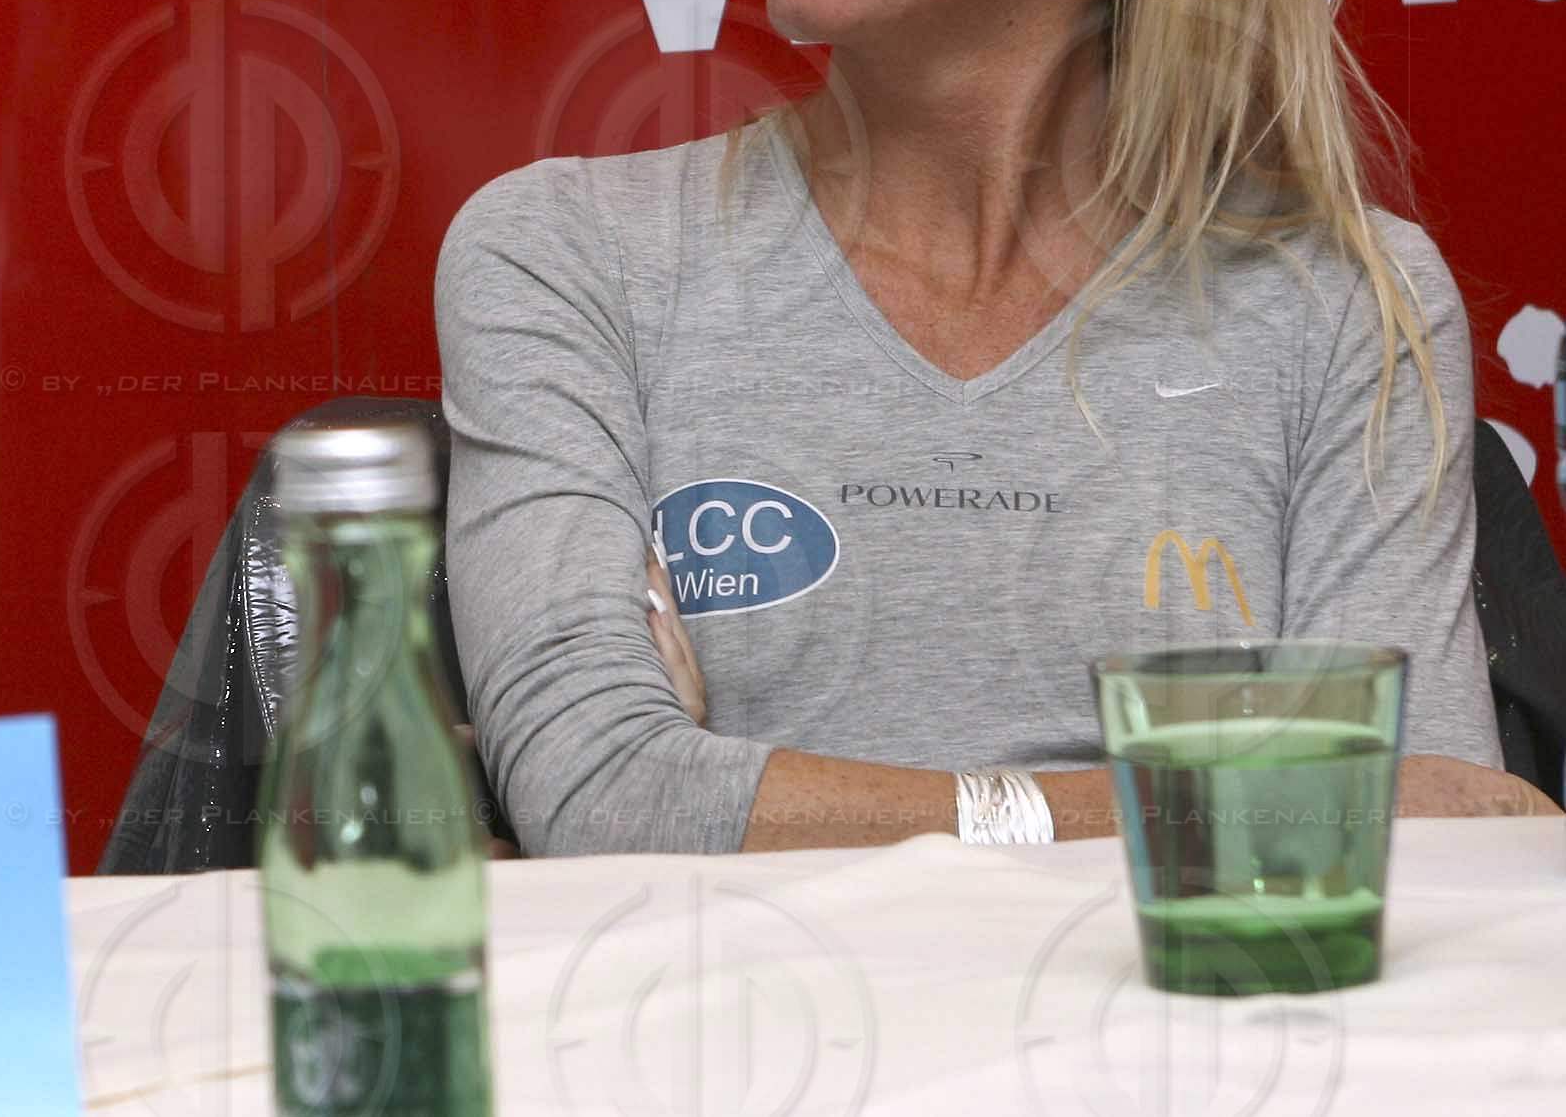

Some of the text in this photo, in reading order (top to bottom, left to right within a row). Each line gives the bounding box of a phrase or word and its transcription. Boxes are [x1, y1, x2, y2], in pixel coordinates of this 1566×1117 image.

[840, 483, 1063, 514] POWERADE
[654, 499, 794, 563] LCC
[675, 572, 760, 603] Wien
